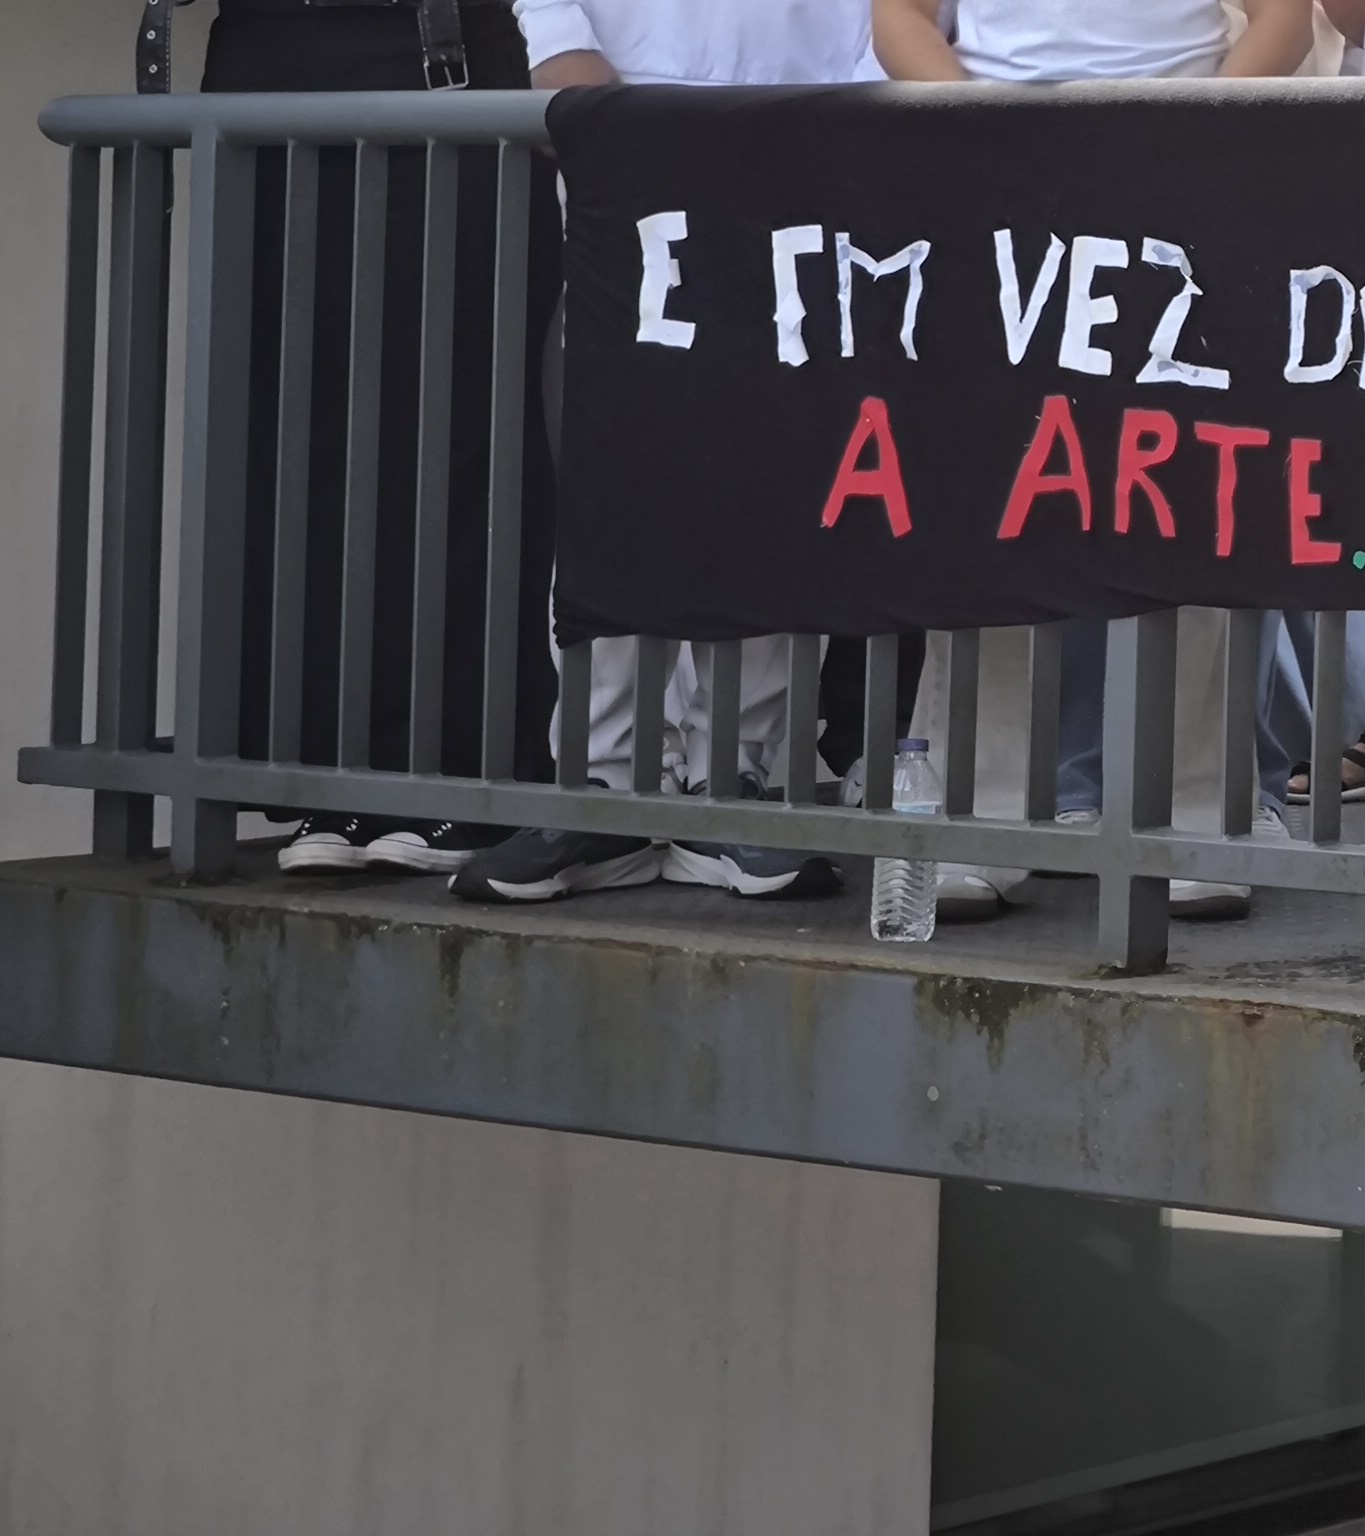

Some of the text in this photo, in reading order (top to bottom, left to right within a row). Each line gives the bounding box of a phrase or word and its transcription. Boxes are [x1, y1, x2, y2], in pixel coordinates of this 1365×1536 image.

[635, 211, 696, 350] E
[994, 228, 1229, 390] VEZ
[820, 395, 912, 539] A
